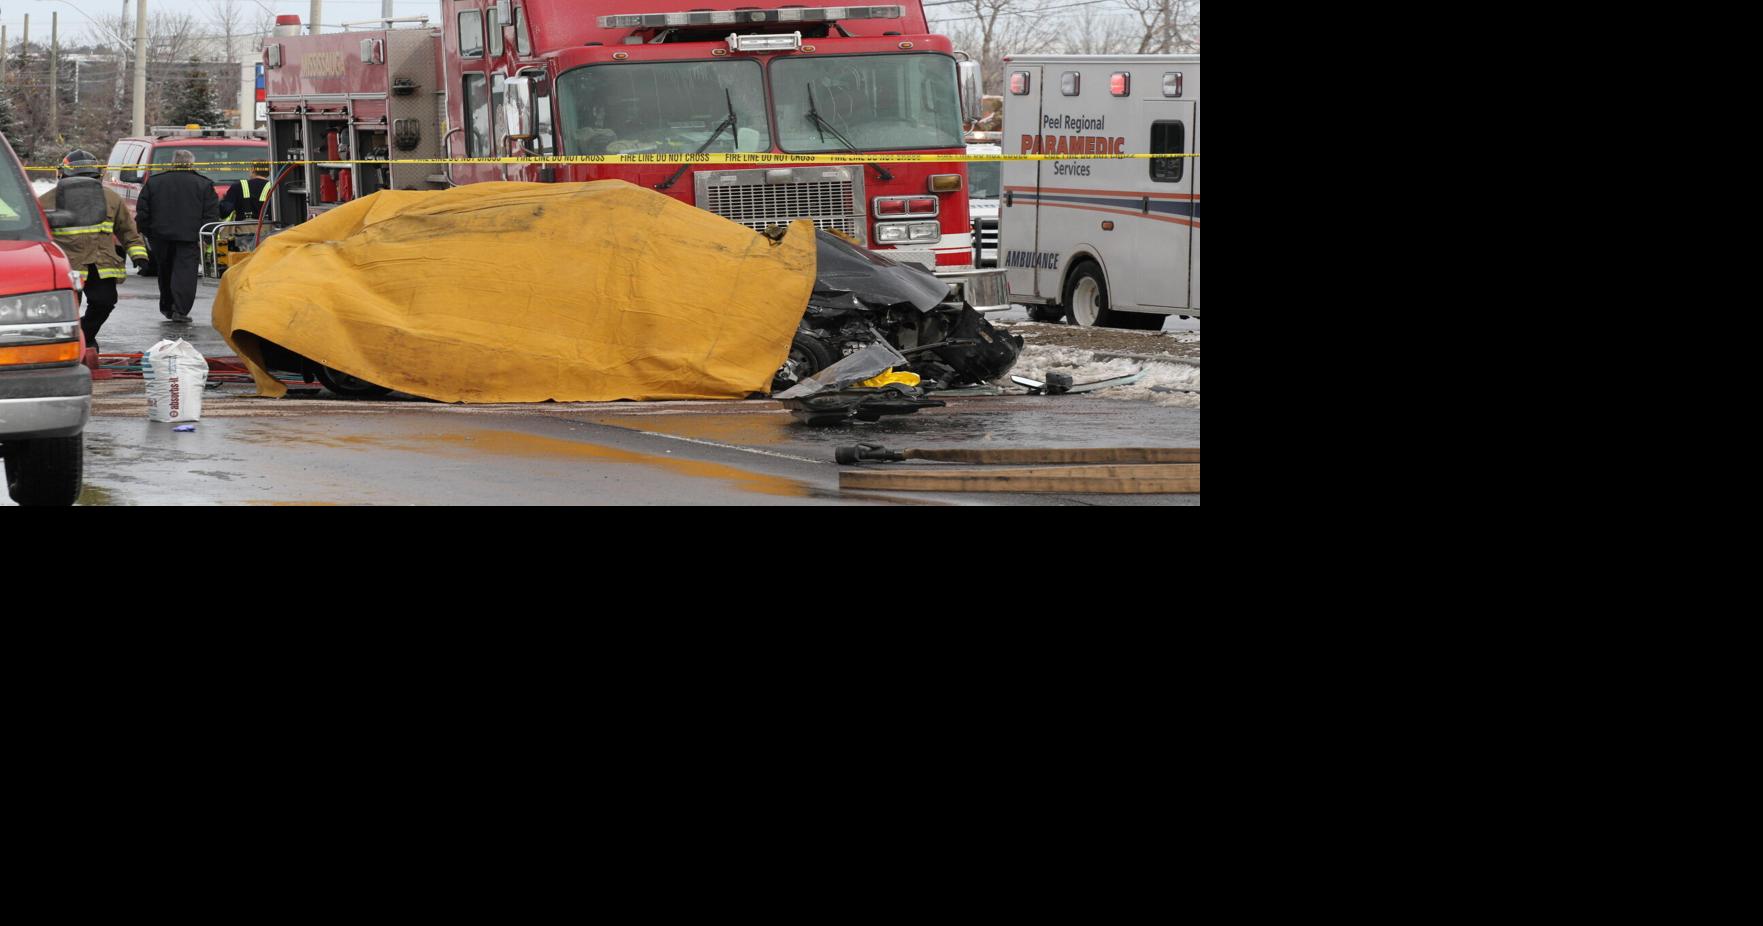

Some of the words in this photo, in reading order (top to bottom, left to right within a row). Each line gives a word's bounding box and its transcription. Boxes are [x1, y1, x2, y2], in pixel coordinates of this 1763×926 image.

[1043, 115, 1062, 129] Peel
[1065, 115, 1104, 133] Regional
[1021, 134, 1125, 156] PARAMEDIC
[620, 154, 636, 162] FIRE
[638, 154, 655, 162] LINE
[656, 153, 667, 161] DO
[668, 153, 683, 161] NOT
[685, 153, 710, 161] CROSS
[725, 154, 742, 162] FIRE
[743, 154, 759, 162] LINE
[1054, 161, 1091, 176] Services
[1005, 250, 1059, 270] AMBULANCE
